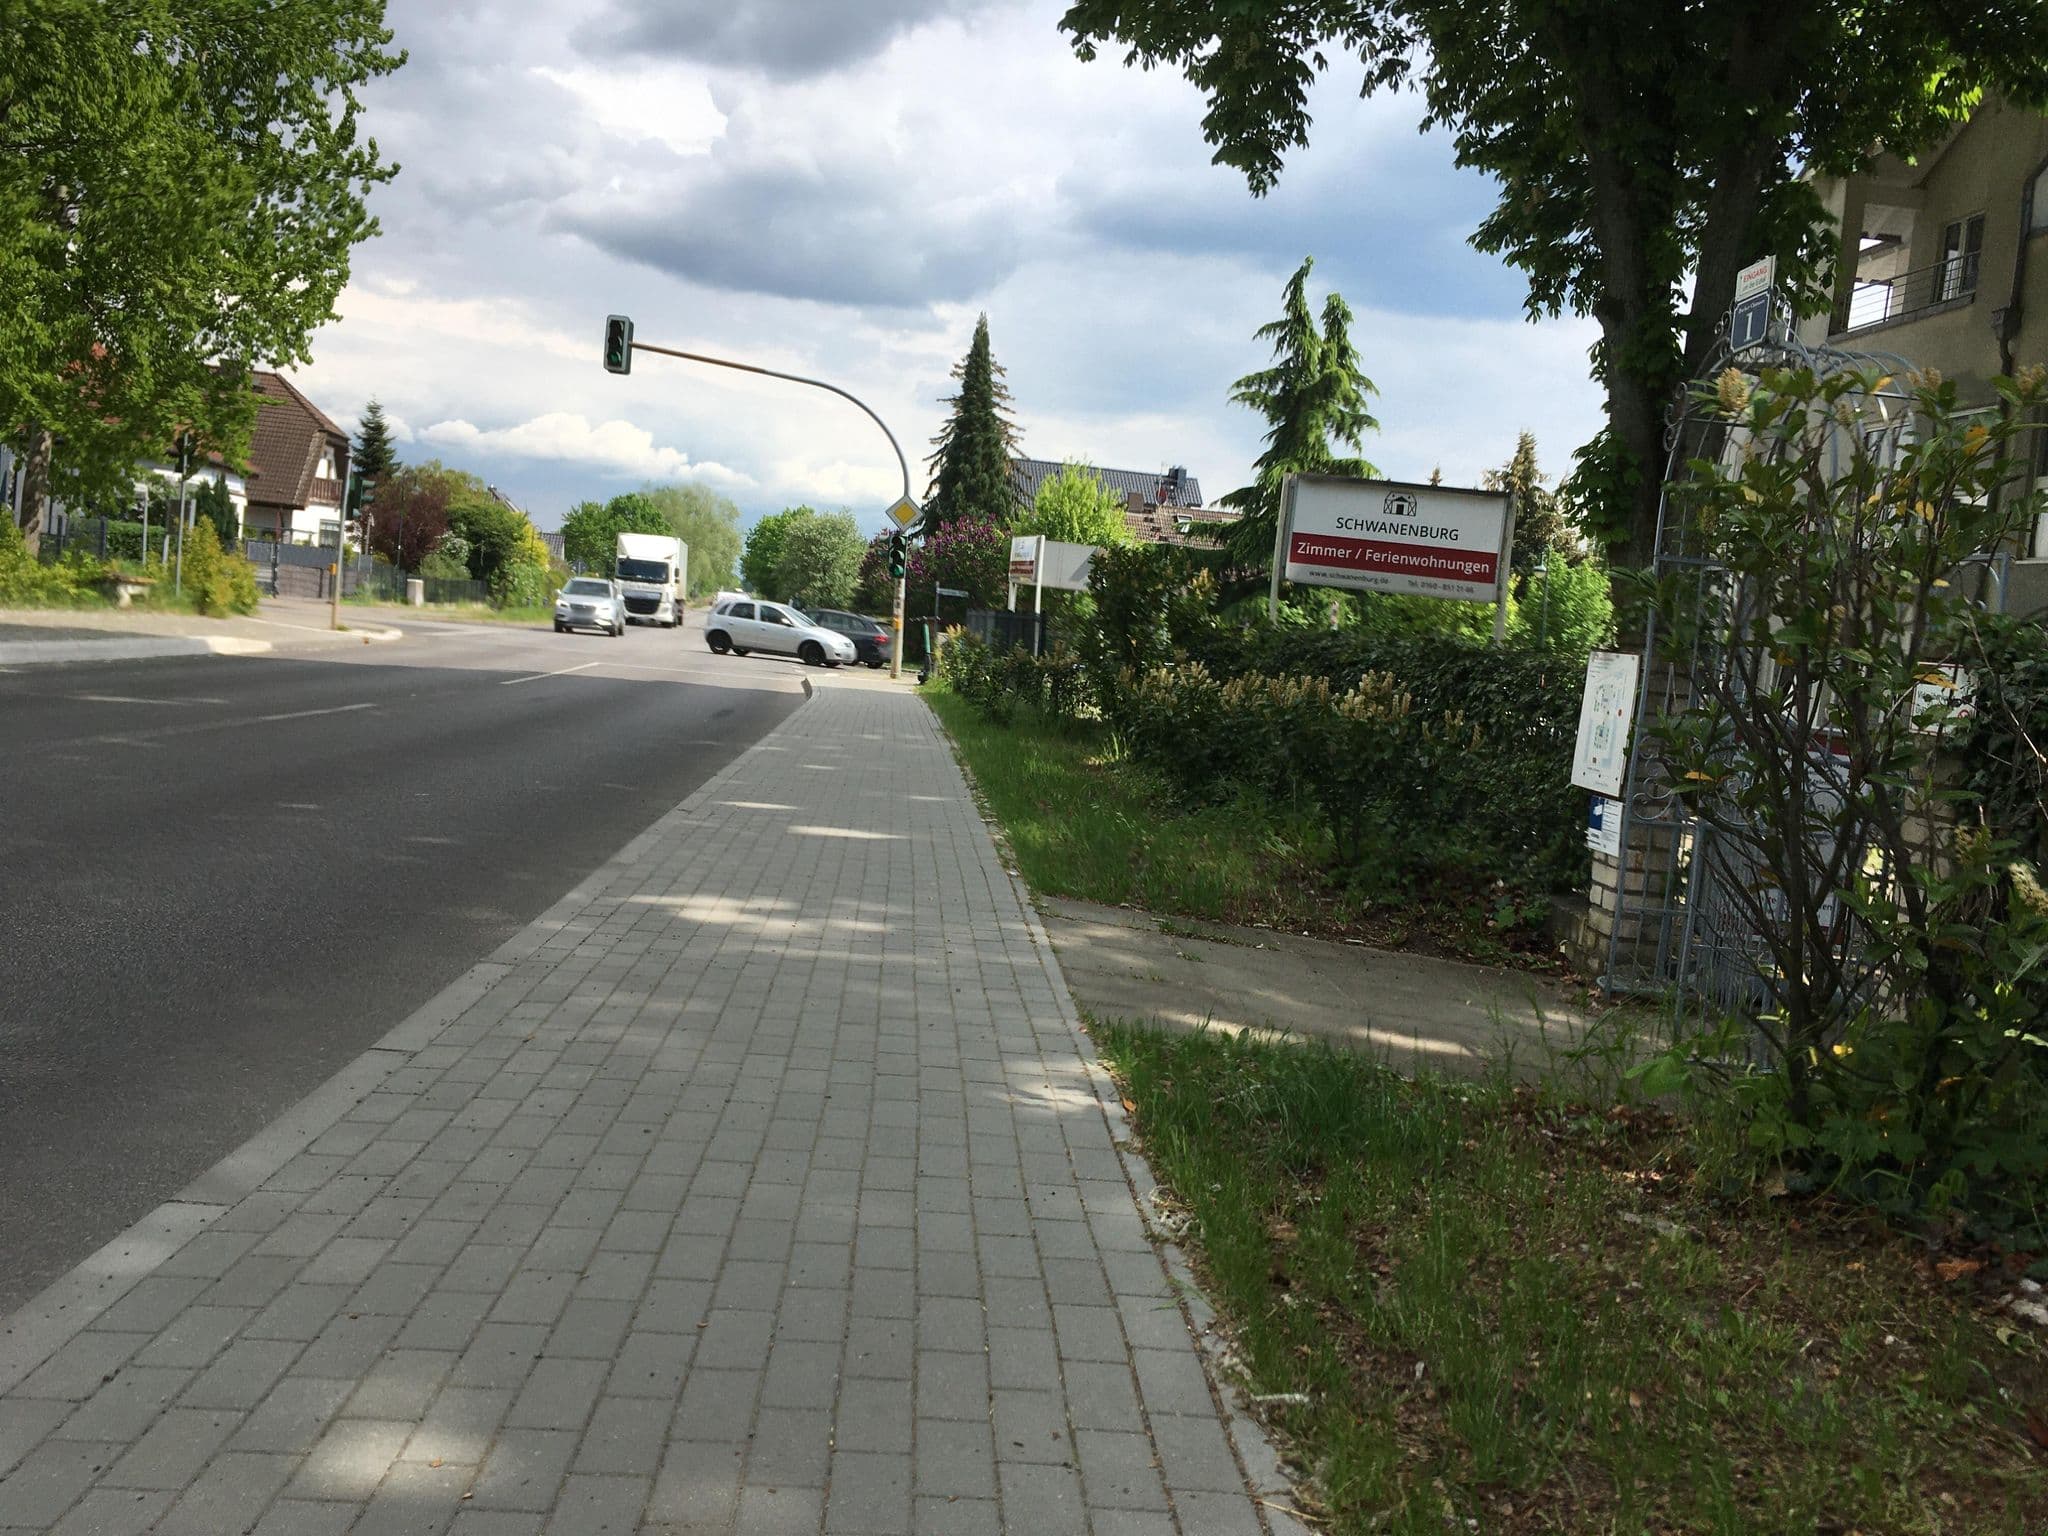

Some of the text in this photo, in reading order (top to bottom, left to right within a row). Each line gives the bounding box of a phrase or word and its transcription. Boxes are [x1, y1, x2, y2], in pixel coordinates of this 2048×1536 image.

[1743, 311, 1753, 342] 1
[1336, 517, 1459, 541] SCHWANENBURG
[1297, 542, 1490, 574] Zimmer / Ferienwohnungen
